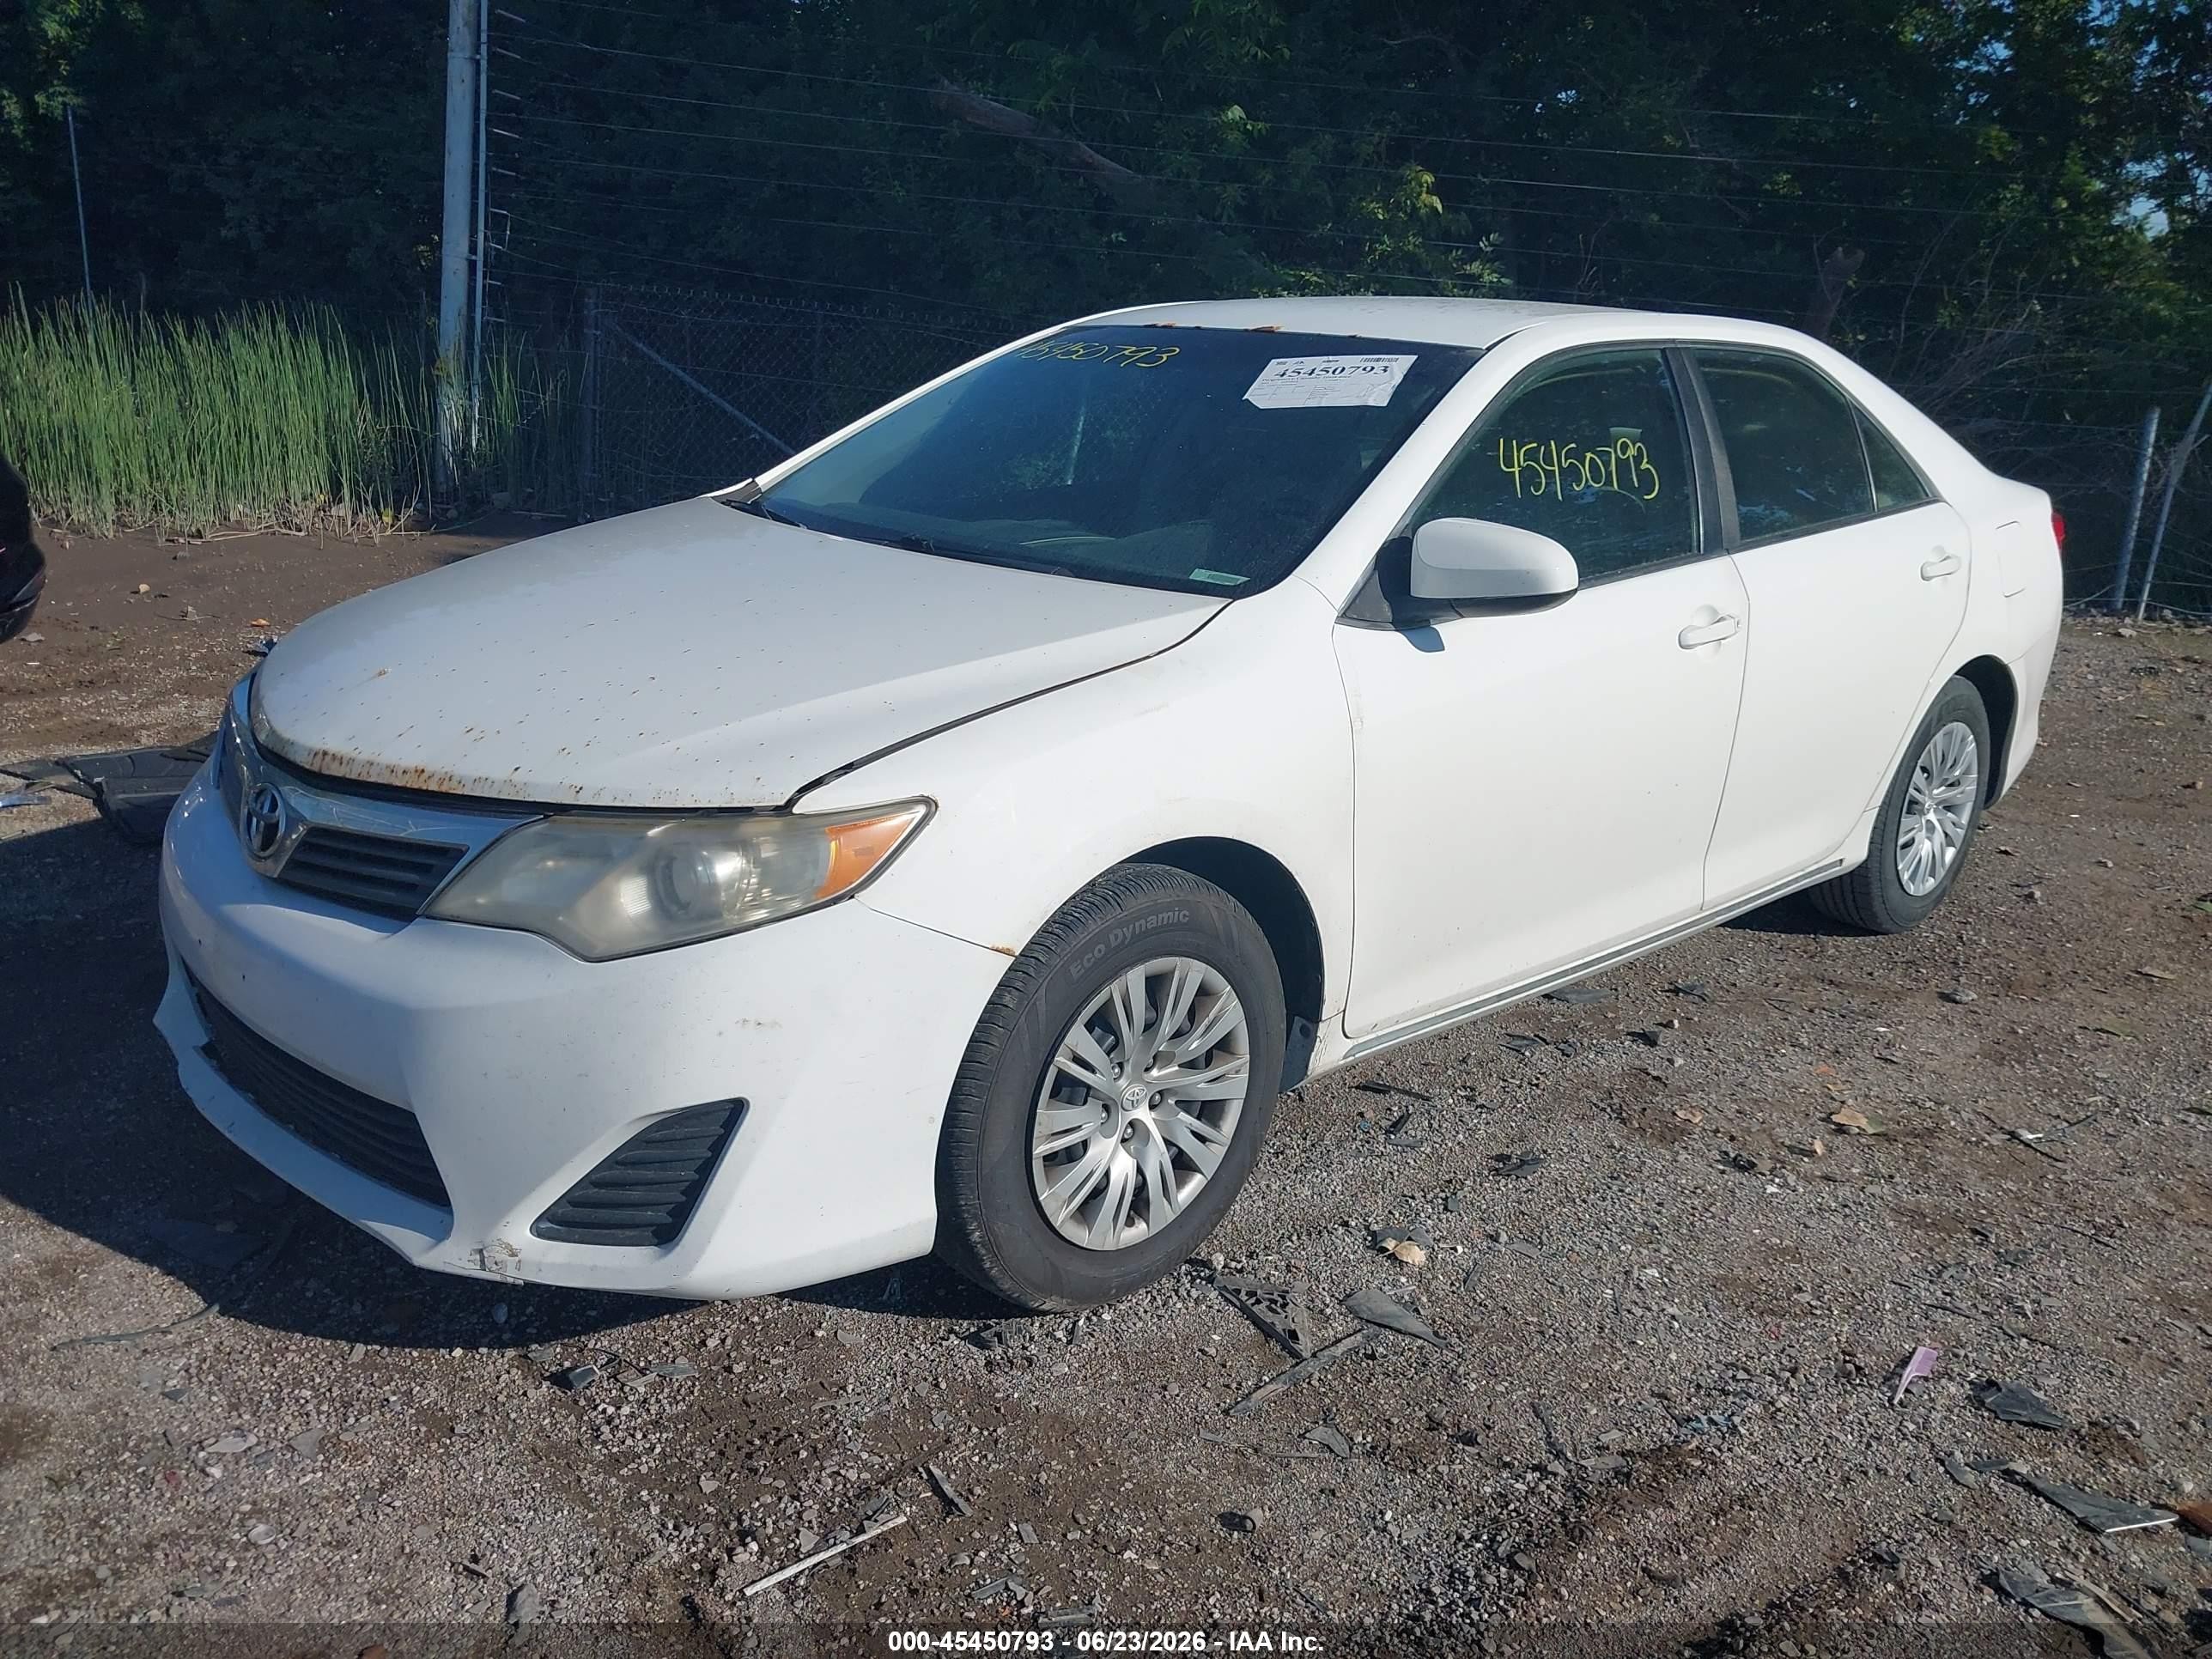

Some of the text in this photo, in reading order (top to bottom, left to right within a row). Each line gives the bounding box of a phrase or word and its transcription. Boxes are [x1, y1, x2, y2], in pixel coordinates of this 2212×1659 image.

[1273, 365, 1390, 379] 45450793
[1498, 437, 1660, 501] 45450793
[1069, 907, 1190, 979] Eco Dynamic
